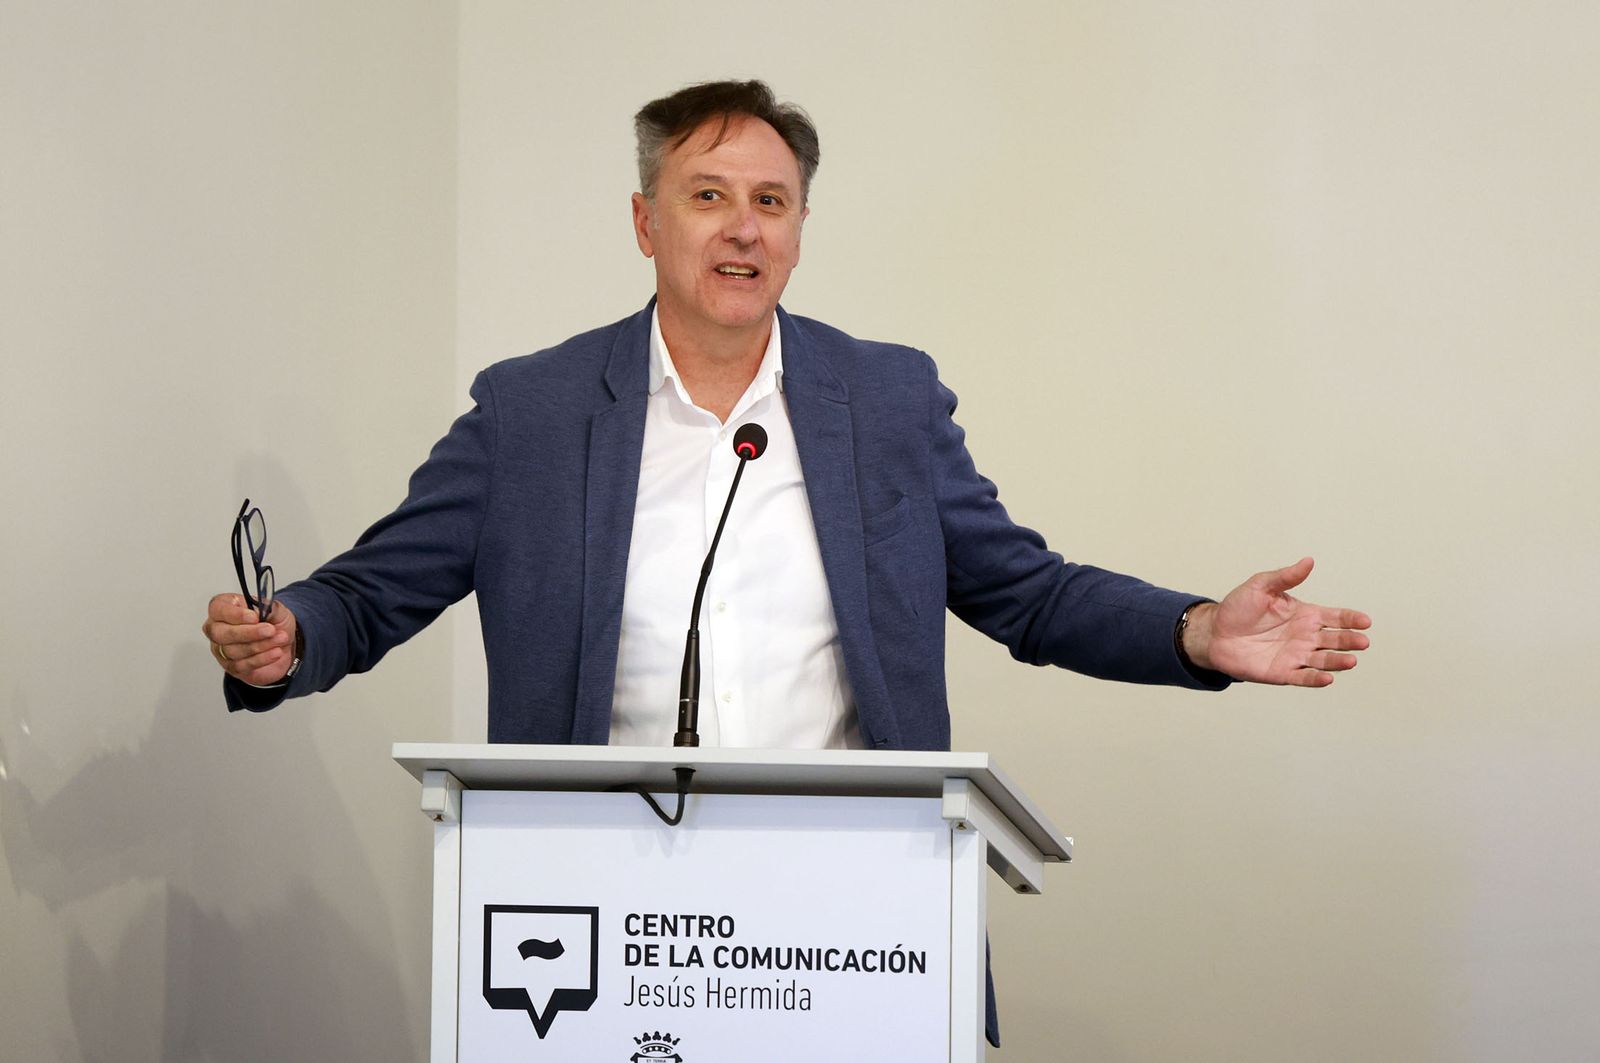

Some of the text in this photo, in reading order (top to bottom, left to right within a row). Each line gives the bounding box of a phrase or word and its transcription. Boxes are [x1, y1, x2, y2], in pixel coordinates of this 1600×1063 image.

[624, 913, 735, 939] CENTRO
[624, 943, 926, 974] DE LA COMUNICACIÓN
[623, 975, 811, 1011] Jesús Hermida
